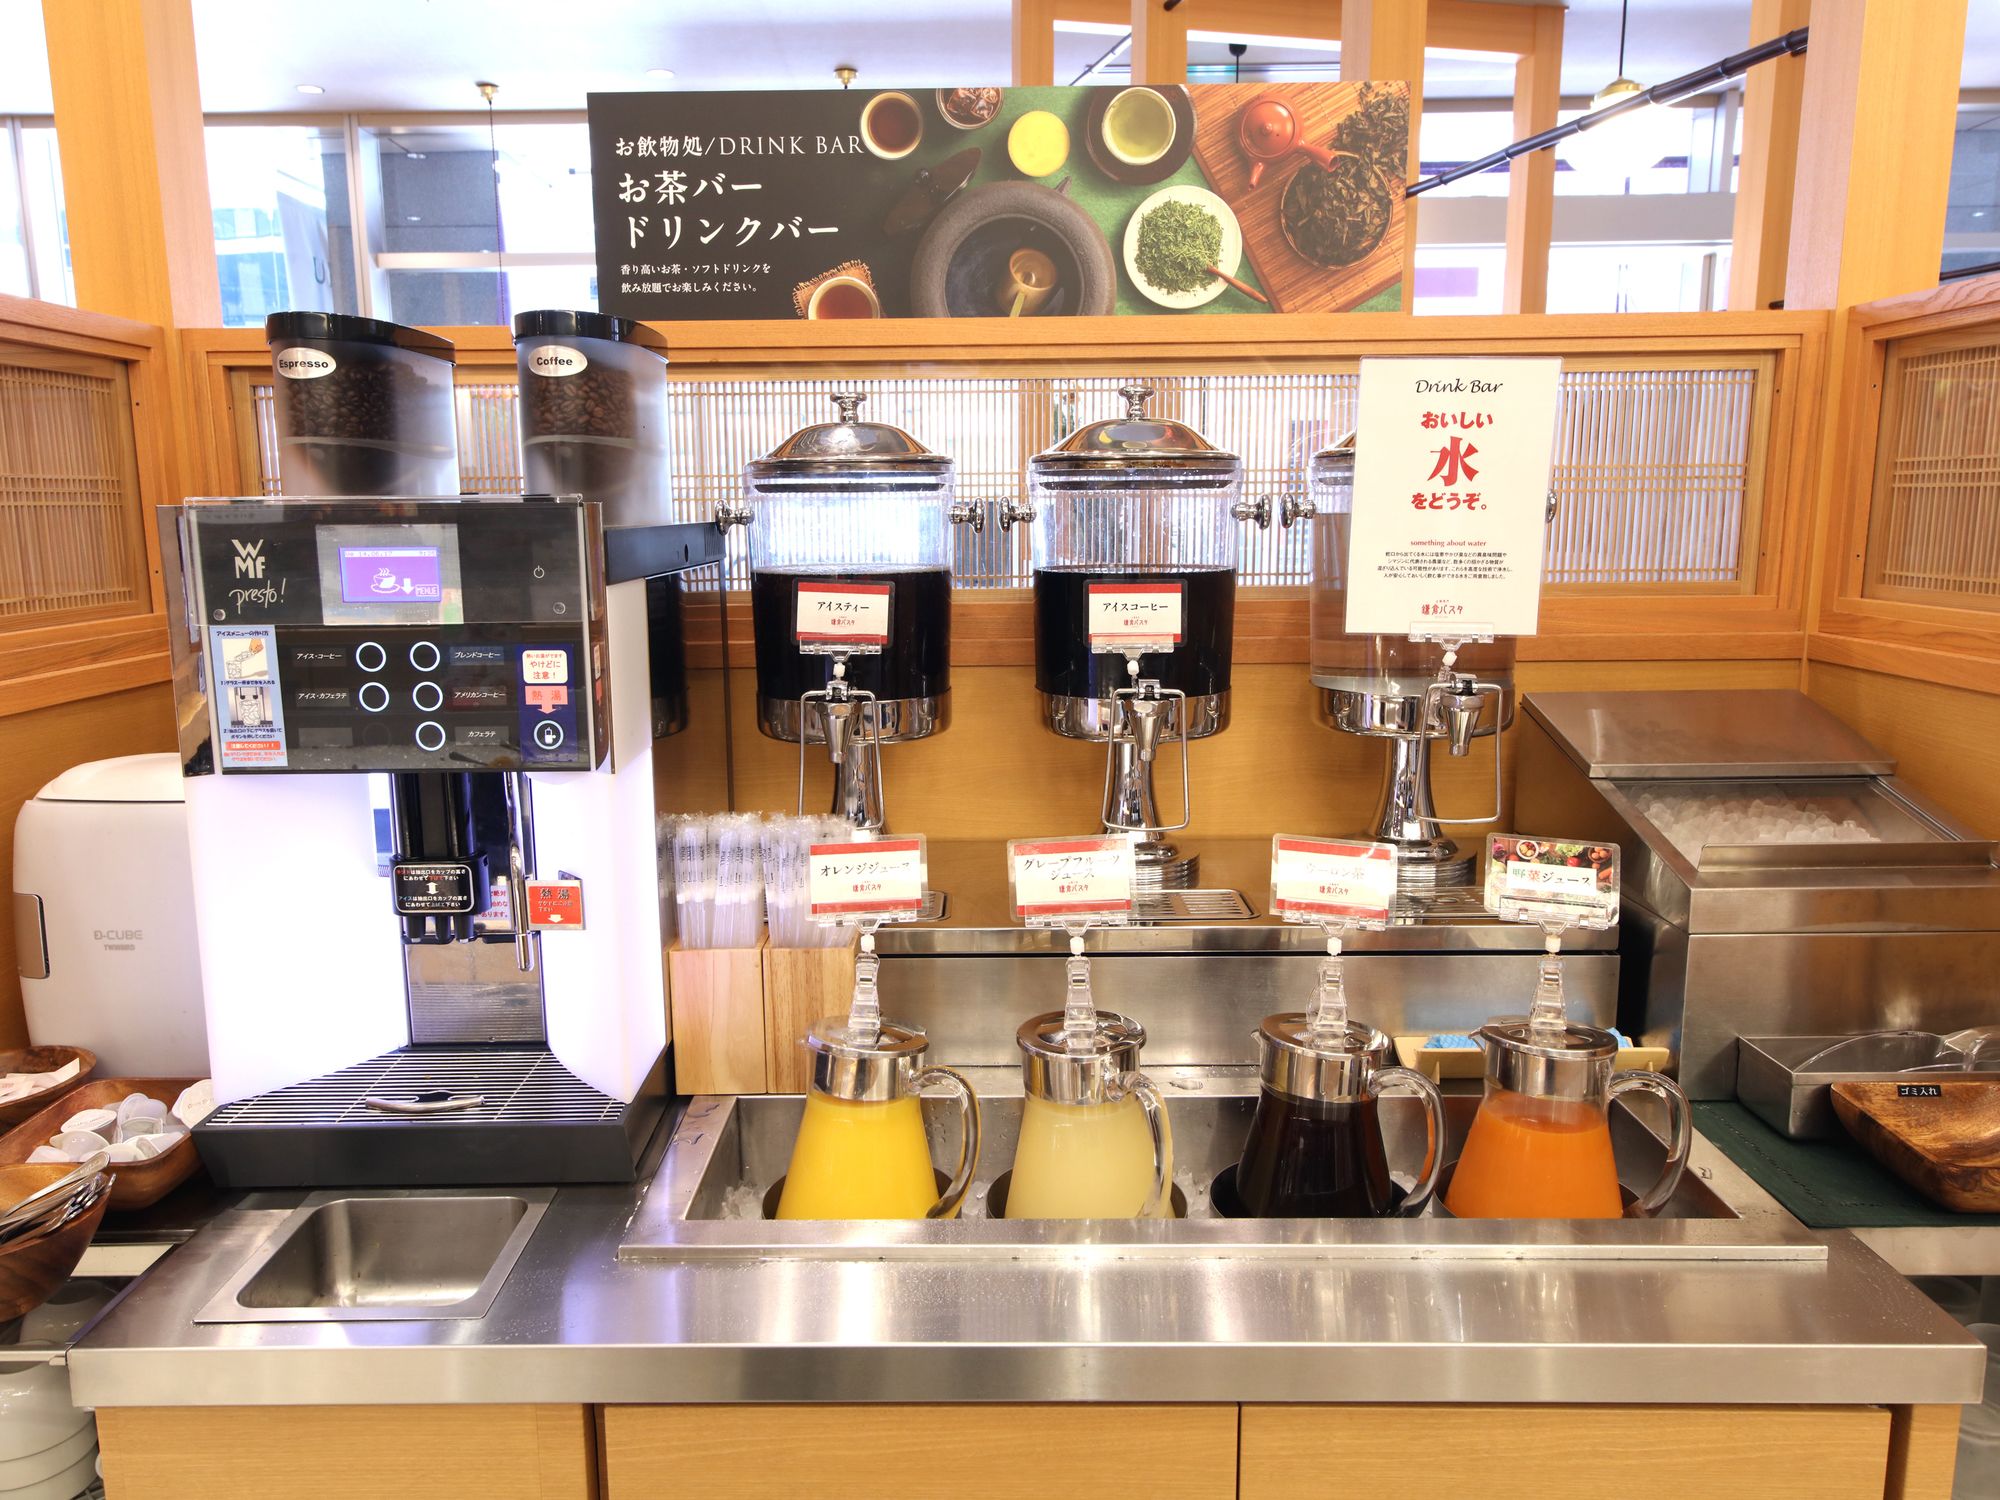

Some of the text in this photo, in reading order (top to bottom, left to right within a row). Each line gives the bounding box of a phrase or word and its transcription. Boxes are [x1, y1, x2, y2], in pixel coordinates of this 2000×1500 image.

[815, 135, 864, 154] BAR
[618, 170, 763, 205] お茶バー
[627, 215, 839, 250] ドリンクバー
[620, 263, 771, 276] 香り高いお茶・ソフトドリンクを
[621, 282, 758, 294] 飲み放題でお楽しみください。
[279, 358, 329, 370] Espresso
[536, 356, 573, 366] Coffee
[1415, 378, 1503, 394] Drink Bar
[1420, 411, 1494, 429] おいしい
[1427, 435, 1480, 487] 水
[1411, 492, 1487, 510] をどうぞ。
[1410, 539, 1445, 548] something
[1446, 539, 1466, 547] about
[228, 578, 287, 614] presto!
[817, 601, 870, 612] アイスティー
[1103, 602, 1168, 612] アイスコーヒー
[1421, 603, 1463, 616] 鎌倉パスタ
[296, 652, 342, 660] アイス・コーヒー
[454, 651, 500, 659] ブレンドコーヒー
[530, 660, 561, 669] やけどに
[298, 692, 347, 700] アイス・カフェラテ
[454, 691, 506, 699] アメリカンコーヒー
[467, 730, 496, 738] カフェラテ
[1024, 855, 1120, 871] グレープフルーツ
[1051, 868, 1095, 881] ジュース
[1512, 868, 1592, 887] 野菜ジュース
[94, 930, 143, 940] D-CUBE
[1901, 1087, 1937, 1096] ゴミ入れ
